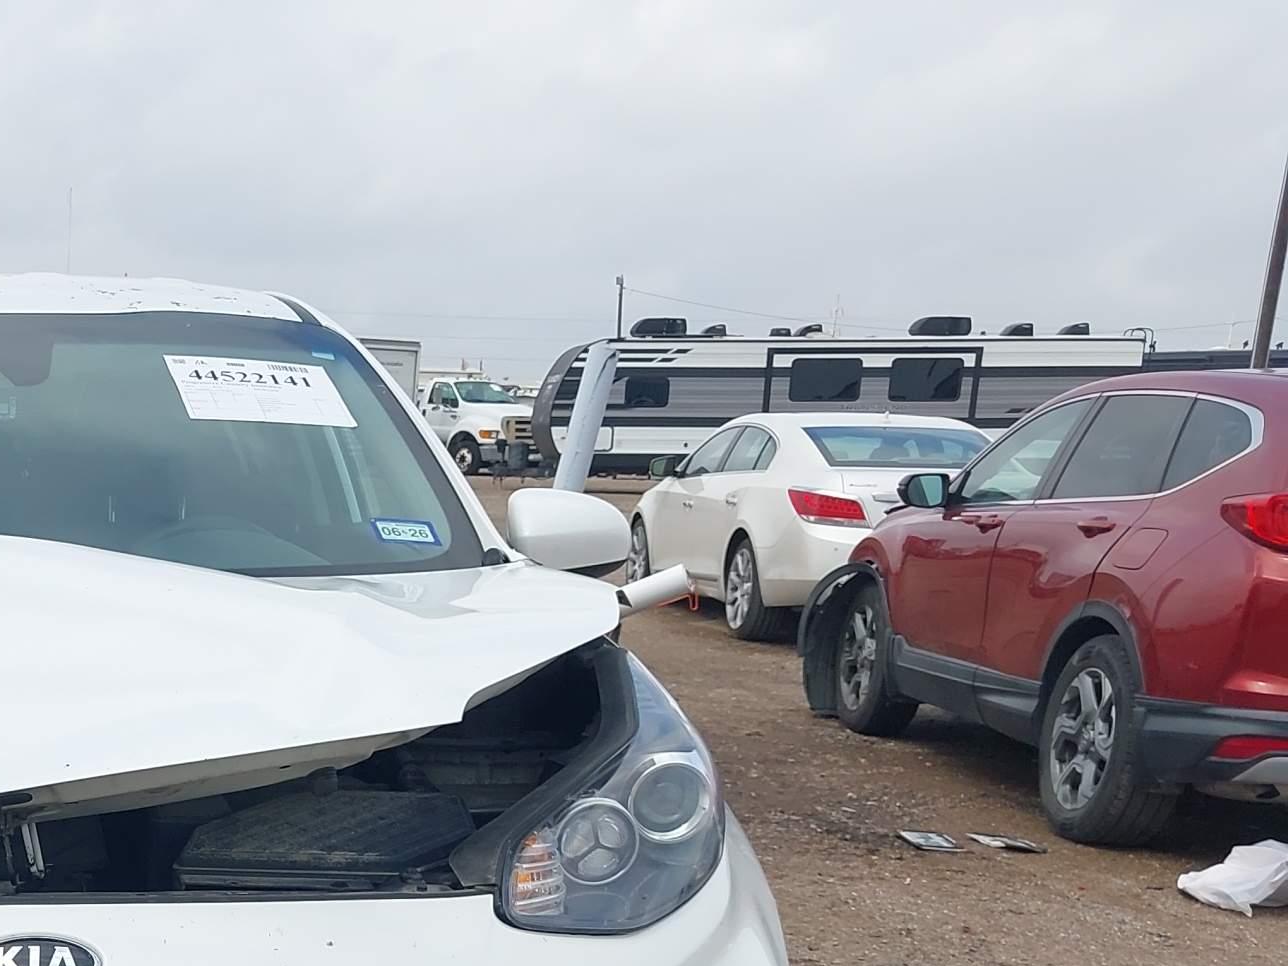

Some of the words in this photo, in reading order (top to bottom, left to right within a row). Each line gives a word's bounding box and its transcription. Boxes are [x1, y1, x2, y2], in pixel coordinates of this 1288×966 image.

[188, 369, 312, 388] 44522141
[381, 526, 402, 537] 06
[408, 528, 429, 539] 26
